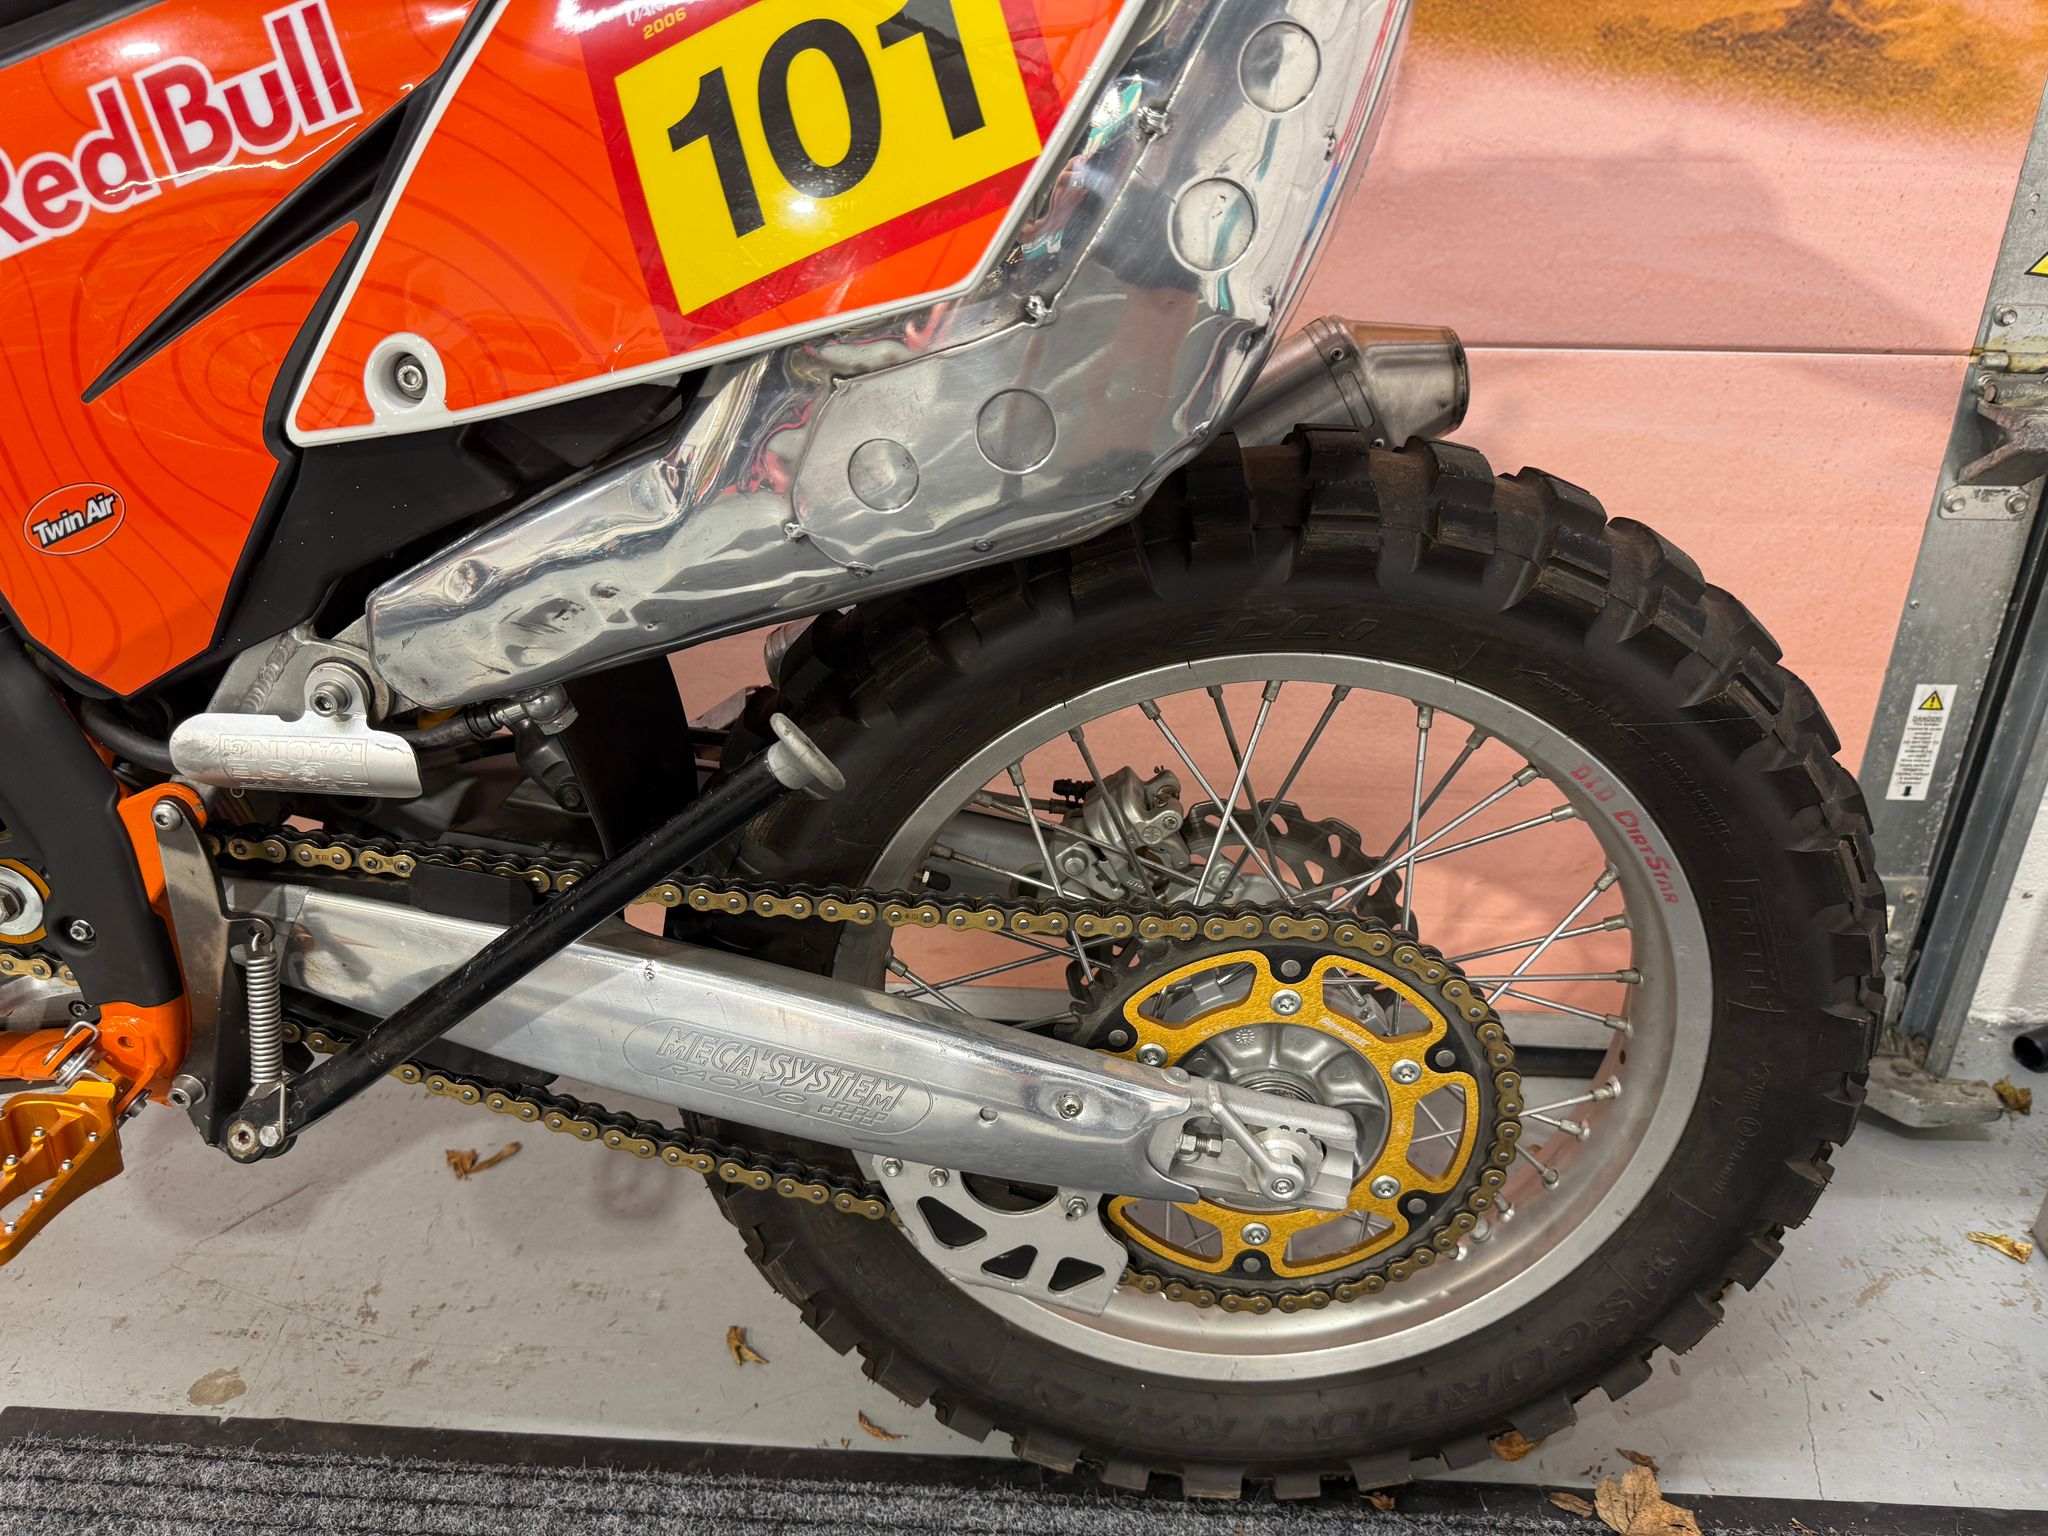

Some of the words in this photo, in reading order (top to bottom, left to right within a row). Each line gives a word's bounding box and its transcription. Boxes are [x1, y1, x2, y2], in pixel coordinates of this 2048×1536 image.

[642, 6, 687, 40] 2006
[142, 2, 355, 171] Bull
[667, 0, 986, 238] 101
[31, 510, 85, 547] Twin
[86, 493, 115, 524] Air
[659, 1063, 808, 1104] RACING
[1260, 1287, 1646, 1443] SCORPION
